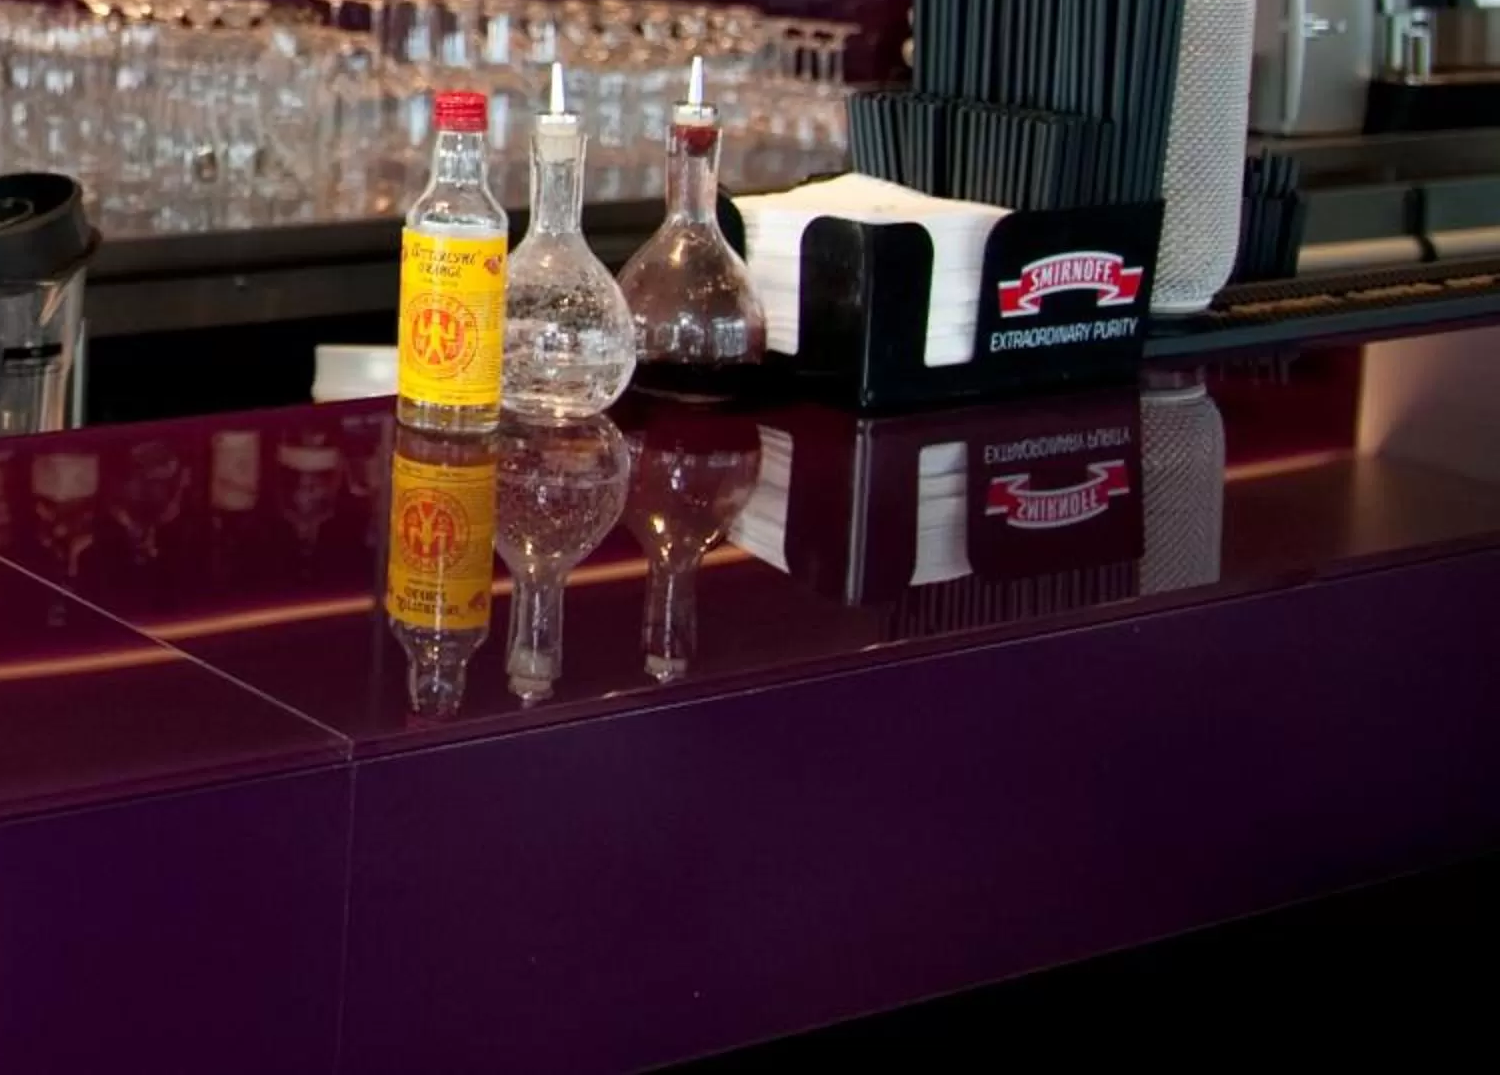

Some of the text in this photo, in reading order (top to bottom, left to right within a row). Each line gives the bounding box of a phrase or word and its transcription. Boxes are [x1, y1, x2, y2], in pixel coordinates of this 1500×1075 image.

[1029, 259, 1113, 292] SMIRNOFF
[989, 317, 1139, 353] EXTRAORDINARY PURITY
